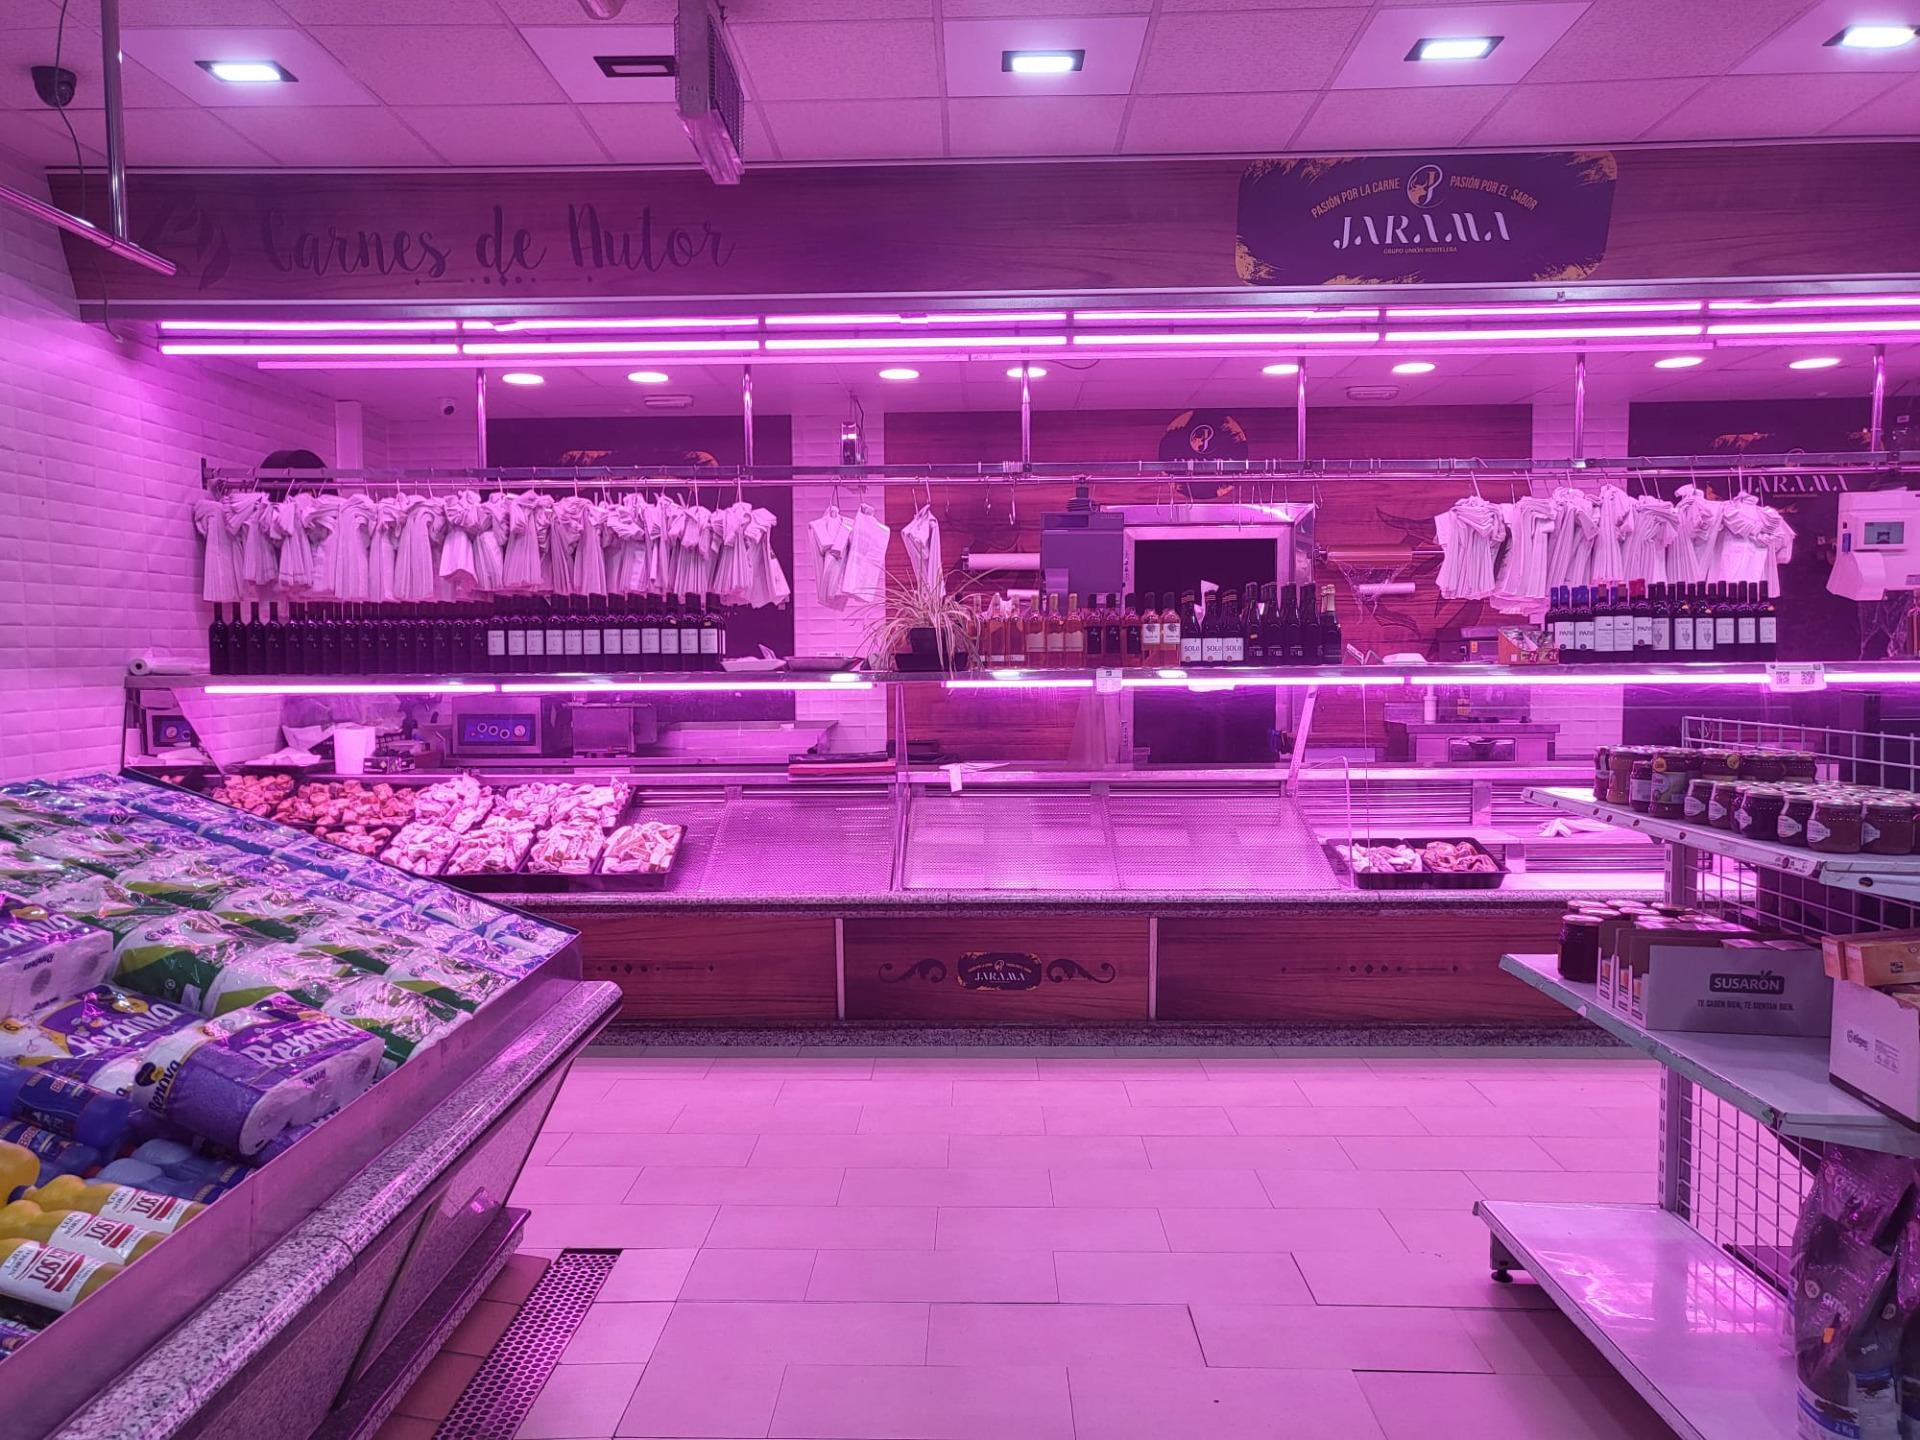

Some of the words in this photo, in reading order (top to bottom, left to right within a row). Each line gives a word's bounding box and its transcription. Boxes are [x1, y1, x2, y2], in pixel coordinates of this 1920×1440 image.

[1311, 195, 1341, 219] PASIÓN
[1341, 189, 1359, 204] POR
[1359, 185, 1371, 197] LA
[1372, 177, 1401, 193] CARNE
[1448, 175, 1480, 190] PASIÓN
[1480, 181, 1498, 193] POR
[1499, 184, 1508, 197] EL
[1510, 186, 1539, 211] SABOR
[260, 204, 451, 278] Carnes
[475, 205, 544, 278] de
[568, 203, 736, 271] Autor
[1332, 211, 1512, 250] JARAMA
[1748, 475, 1848, 494] JARAMA
[974, 971, 1025, 981] JARAMA
[240, 1018, 361, 1070] Renova
[148, 1059, 182, 1114] Renova
[129, 1196, 160, 1214] LOS
[83, 1221, 116, 1241] LOS
[27, 1258, 62, 1283] LOS
